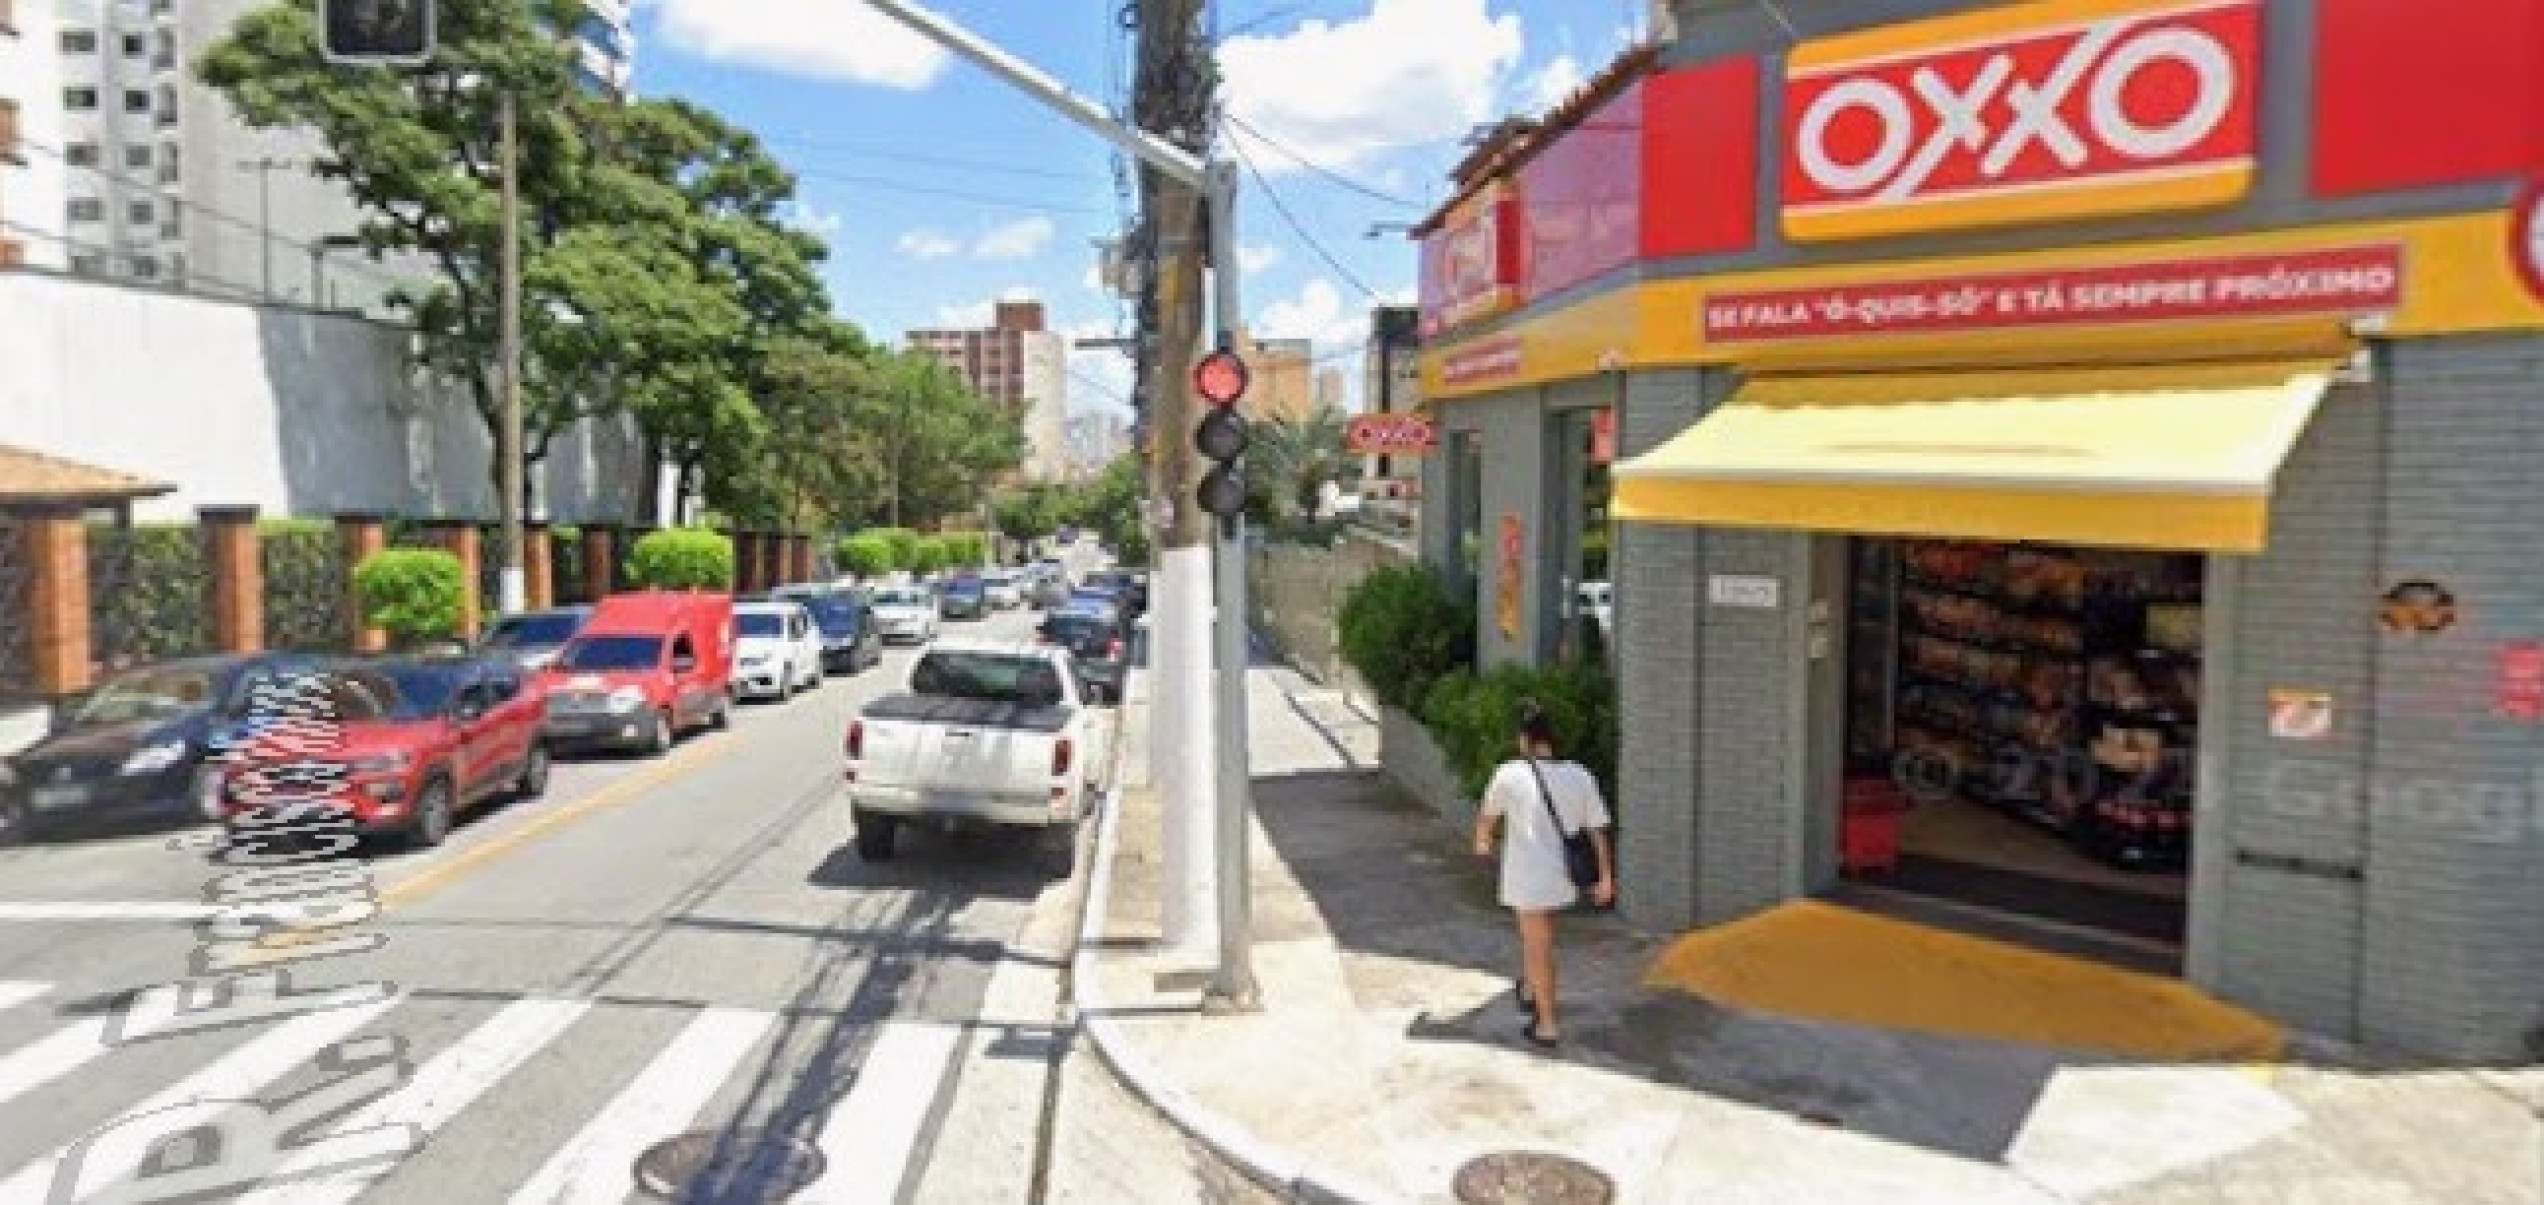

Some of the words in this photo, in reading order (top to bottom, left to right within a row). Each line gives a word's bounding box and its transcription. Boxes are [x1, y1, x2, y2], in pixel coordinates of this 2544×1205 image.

[1797, 18, 2236, 200] OXXO
[1708, 306, 1738, 328] SE
[1742, 301, 1812, 325] FALA
[1997, 287, 2016, 312] E
[2023, 279, 2063, 310] TÁ
[2073, 278, 2206, 311] SEMPRE
[2215, 263, 2395, 301] PRÓXIMO
